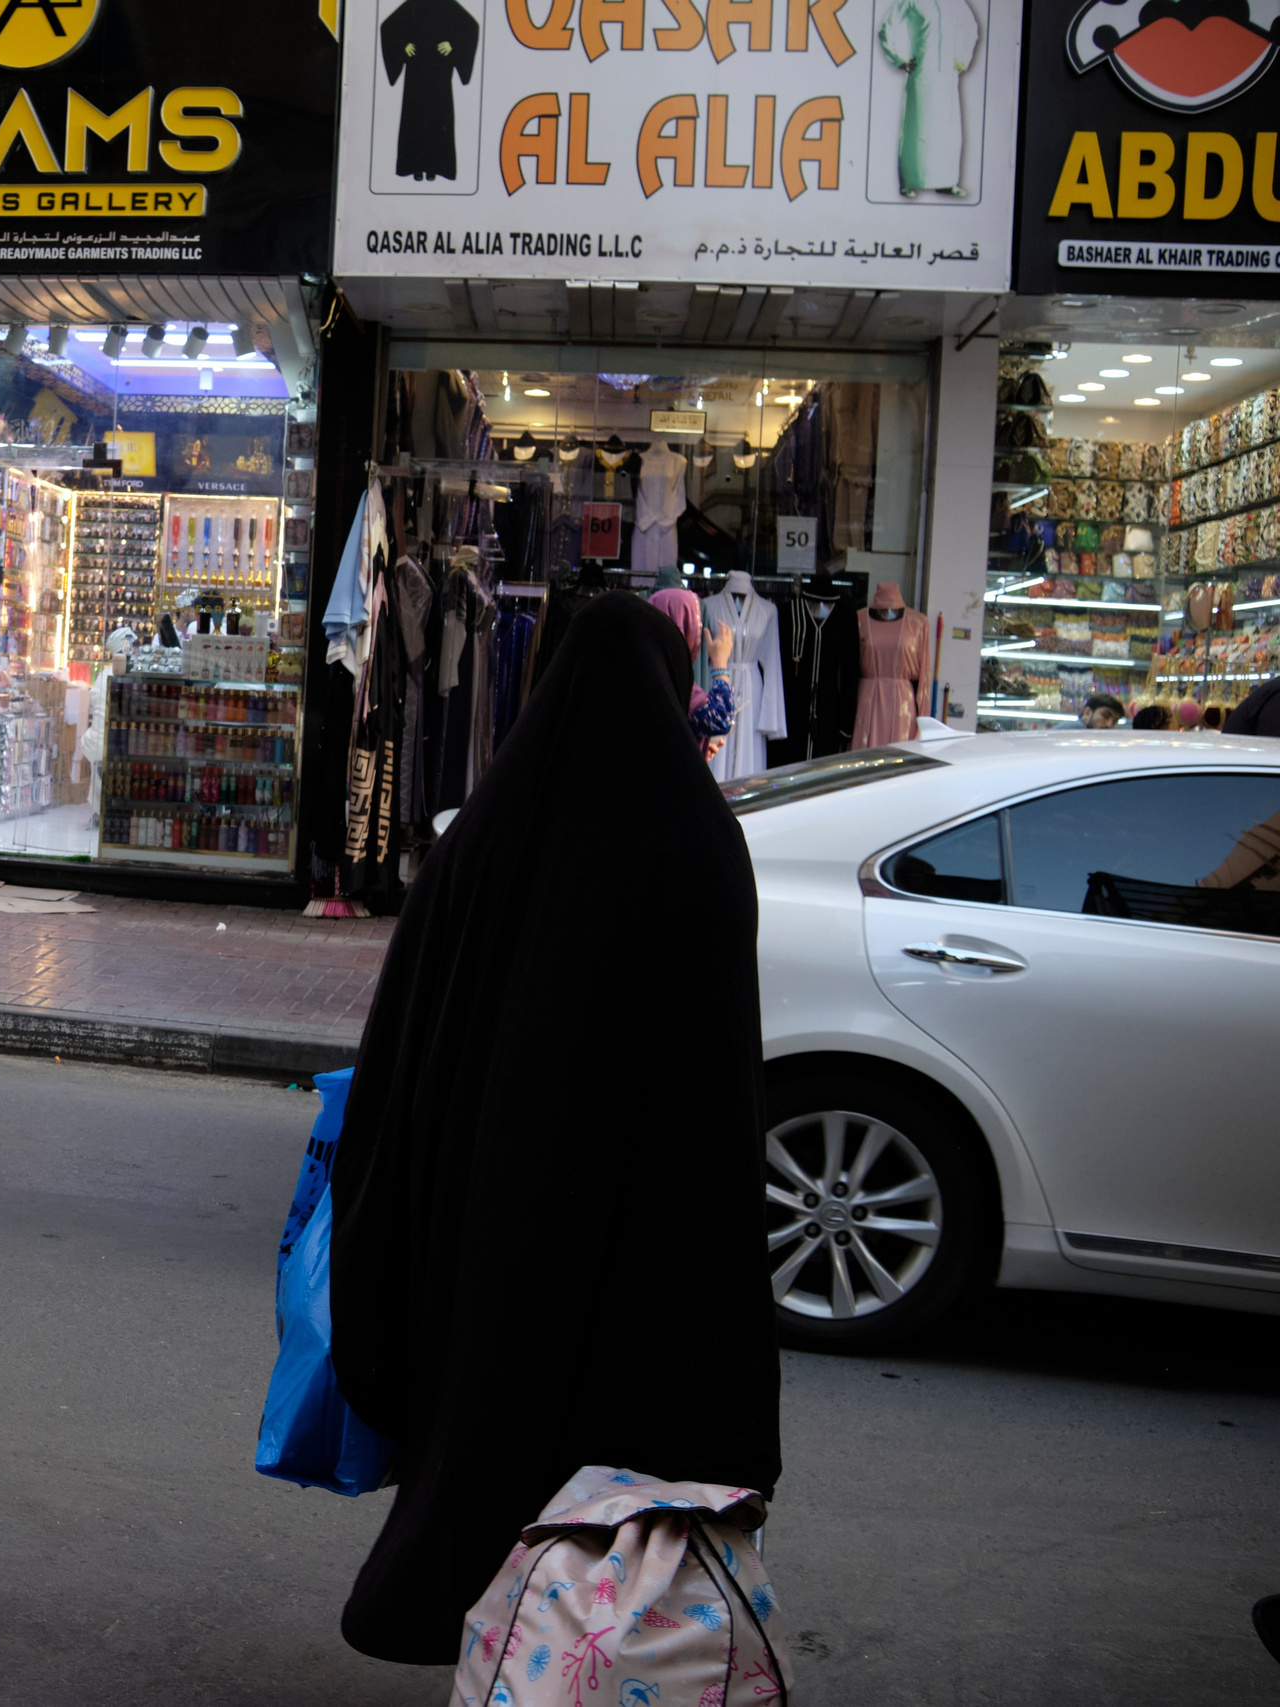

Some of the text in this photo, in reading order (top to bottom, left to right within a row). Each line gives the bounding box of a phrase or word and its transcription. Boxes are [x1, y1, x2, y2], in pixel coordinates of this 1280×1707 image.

[500, 92, 845, 202] AL ALIA
[37, 192, 200, 212] GALLERY
[366, 230, 642, 258] QASAR AL ALIA TRADING L.L.C
[694, 237, 980, 266] قصر العالية للتجارة ذ.م.م
[0, 247, 66, 260] READYMADE
[67, 247, 129, 260] GARMENTS
[130, 247, 180, 260] TRADING
[181, 247, 203, 260] LLC
[1066, 245, 1132, 264] BASHAER
[1136, 247, 1154, 264] AL
[1158, 248, 1202, 266] KHAIR
[1207, 249, 1271, 268] TRADING
[121, 479, 145, 488] FORD
[197, 481, 248, 492] VERSACE
[590, 517, 612, 533] 60
[785, 531, 809, 548] 50
